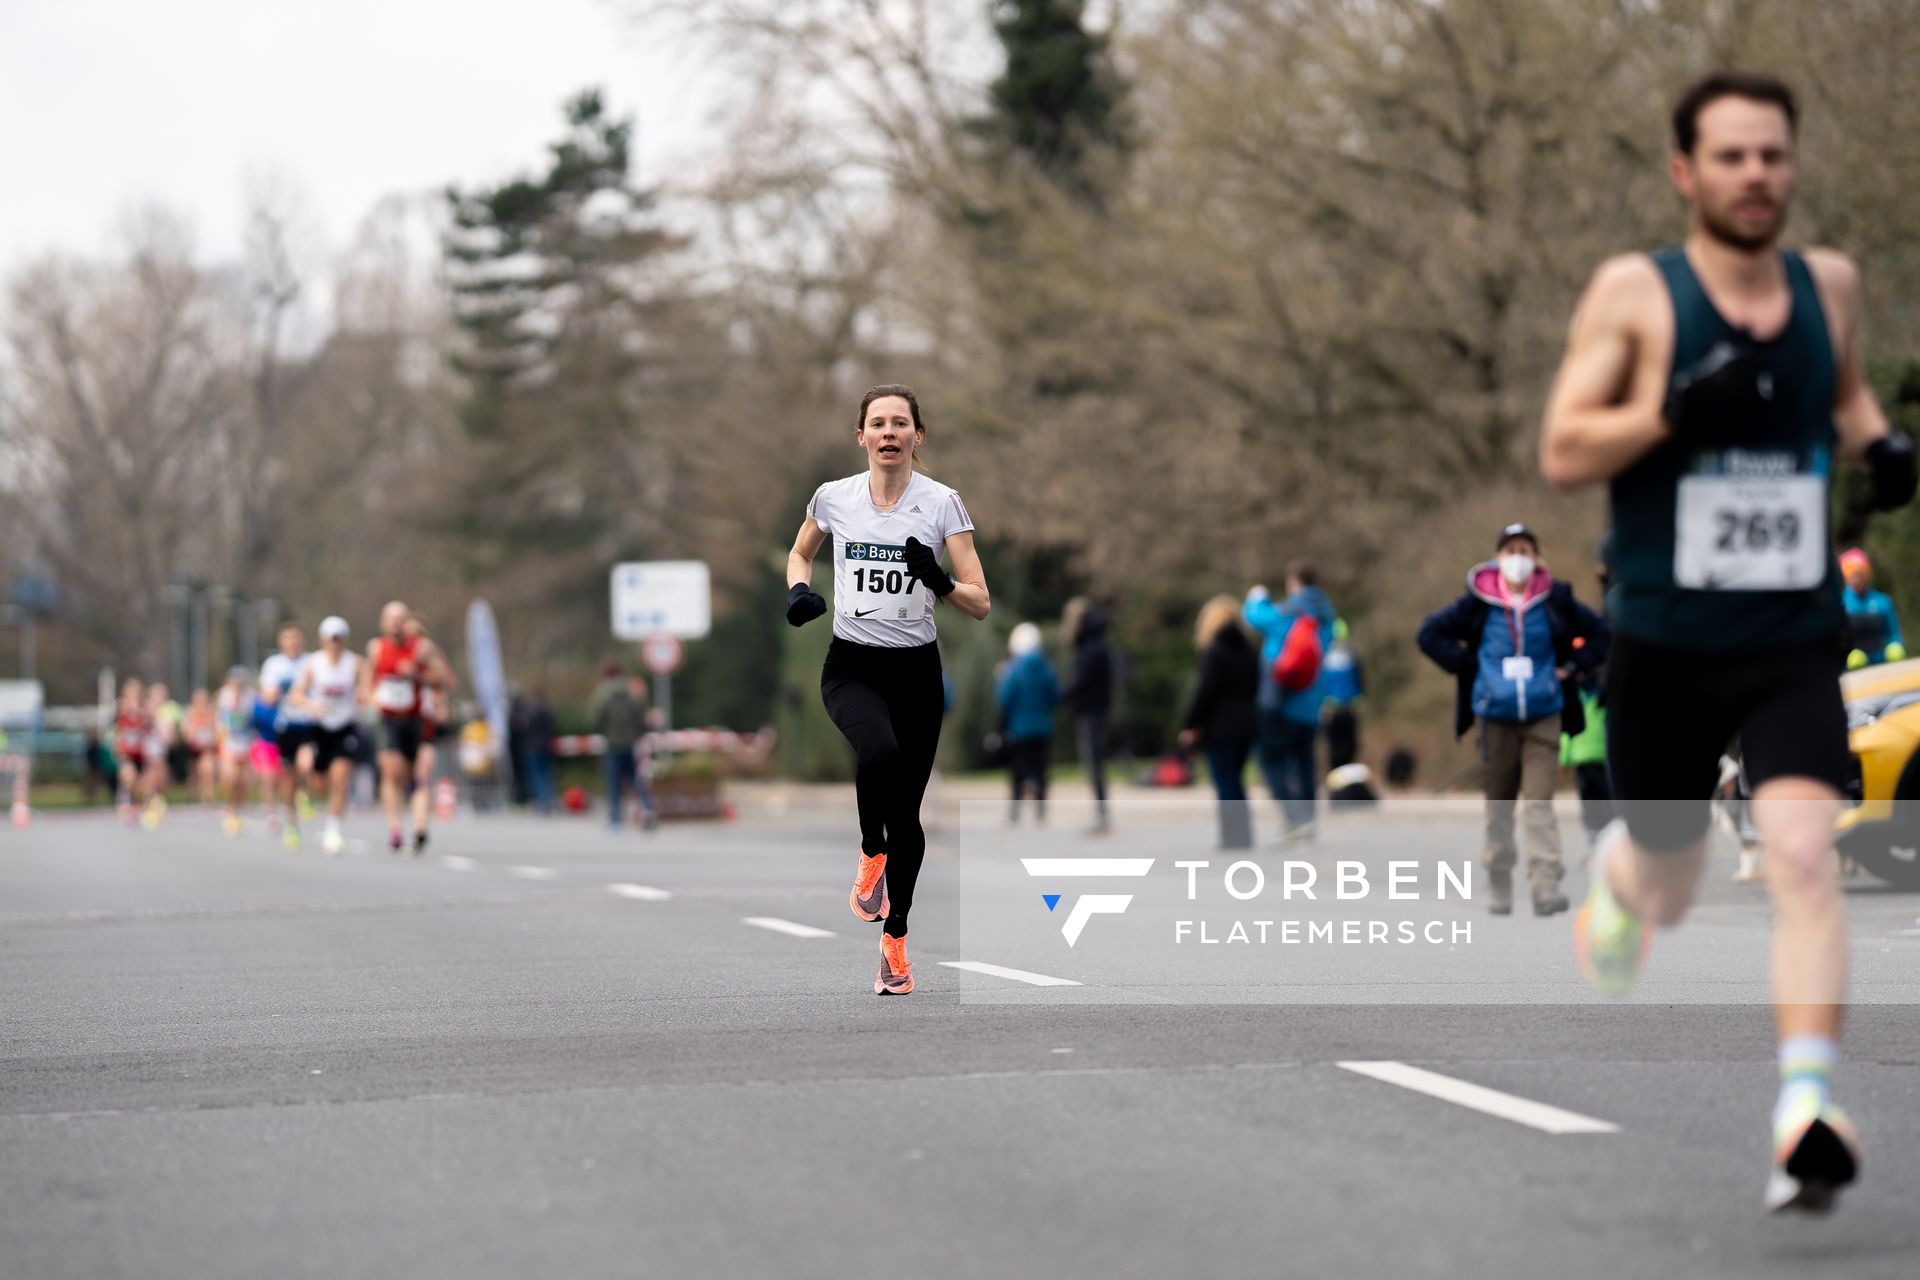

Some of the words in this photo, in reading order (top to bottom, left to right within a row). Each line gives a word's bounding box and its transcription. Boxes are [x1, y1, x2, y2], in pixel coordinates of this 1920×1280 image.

[1716, 509, 1801, 553] 269
[869, 545, 906, 562] Baye
[854, 567, 918, 595] 1507
